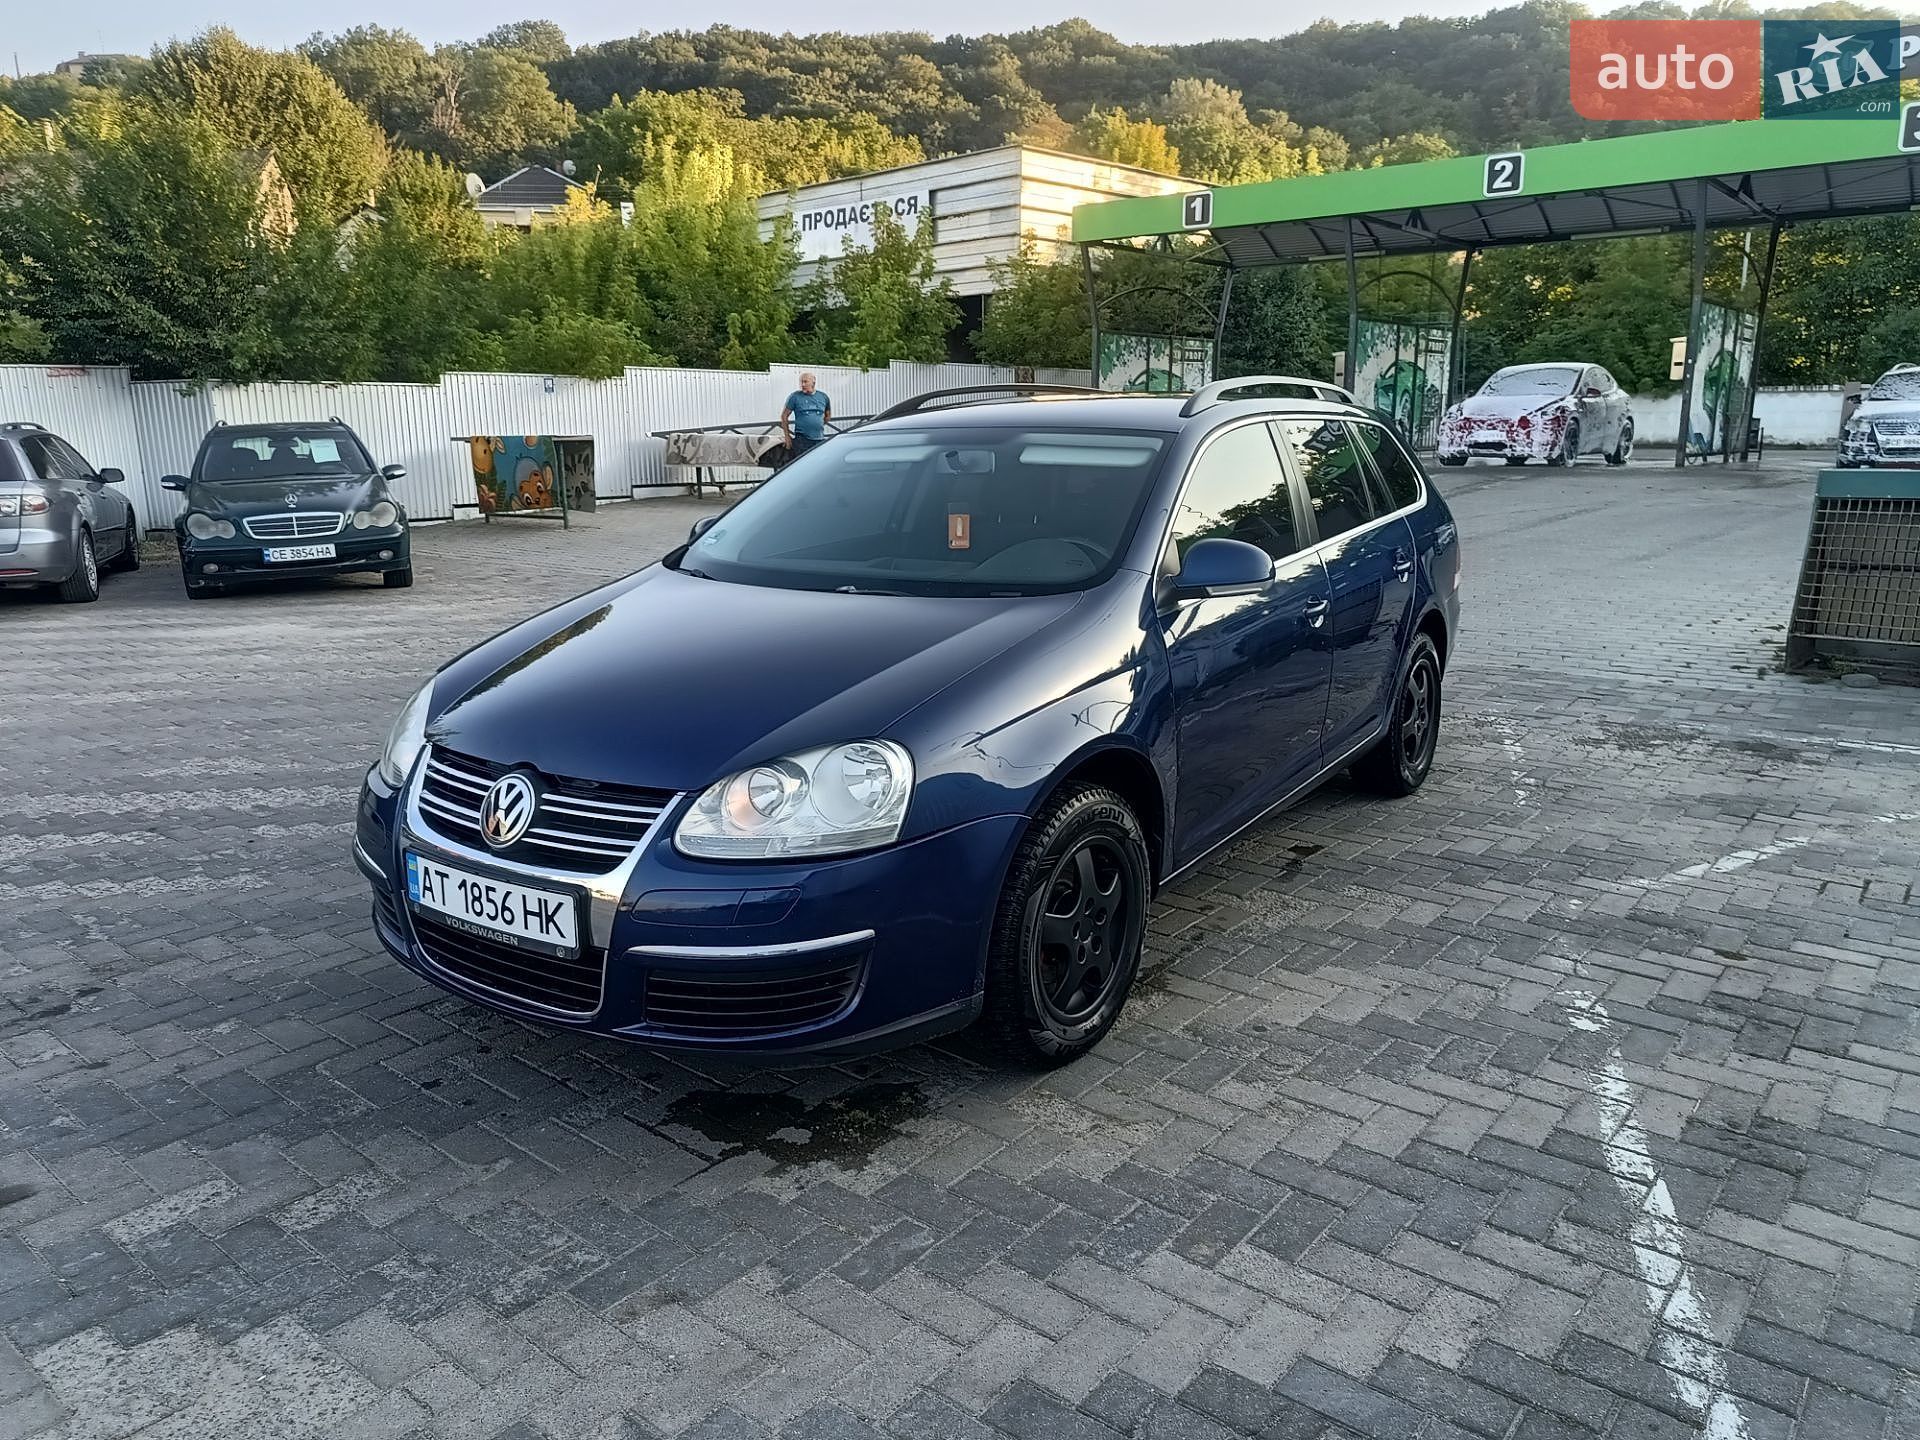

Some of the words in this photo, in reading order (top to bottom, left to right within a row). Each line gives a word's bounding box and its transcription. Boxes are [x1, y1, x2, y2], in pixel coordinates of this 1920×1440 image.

[1492, 160, 1514, 189] 2
[802, 195, 919, 232] ПРОДАЄСЯ
[1190, 197, 1203, 222] 1
[290, 548, 315, 559] 3854
[422, 865, 450, 907] AT
[457, 878, 516, 927] 1856
[521, 894, 567, 939] HK
[446, 916, 519, 946] VOLKSWAGEN
